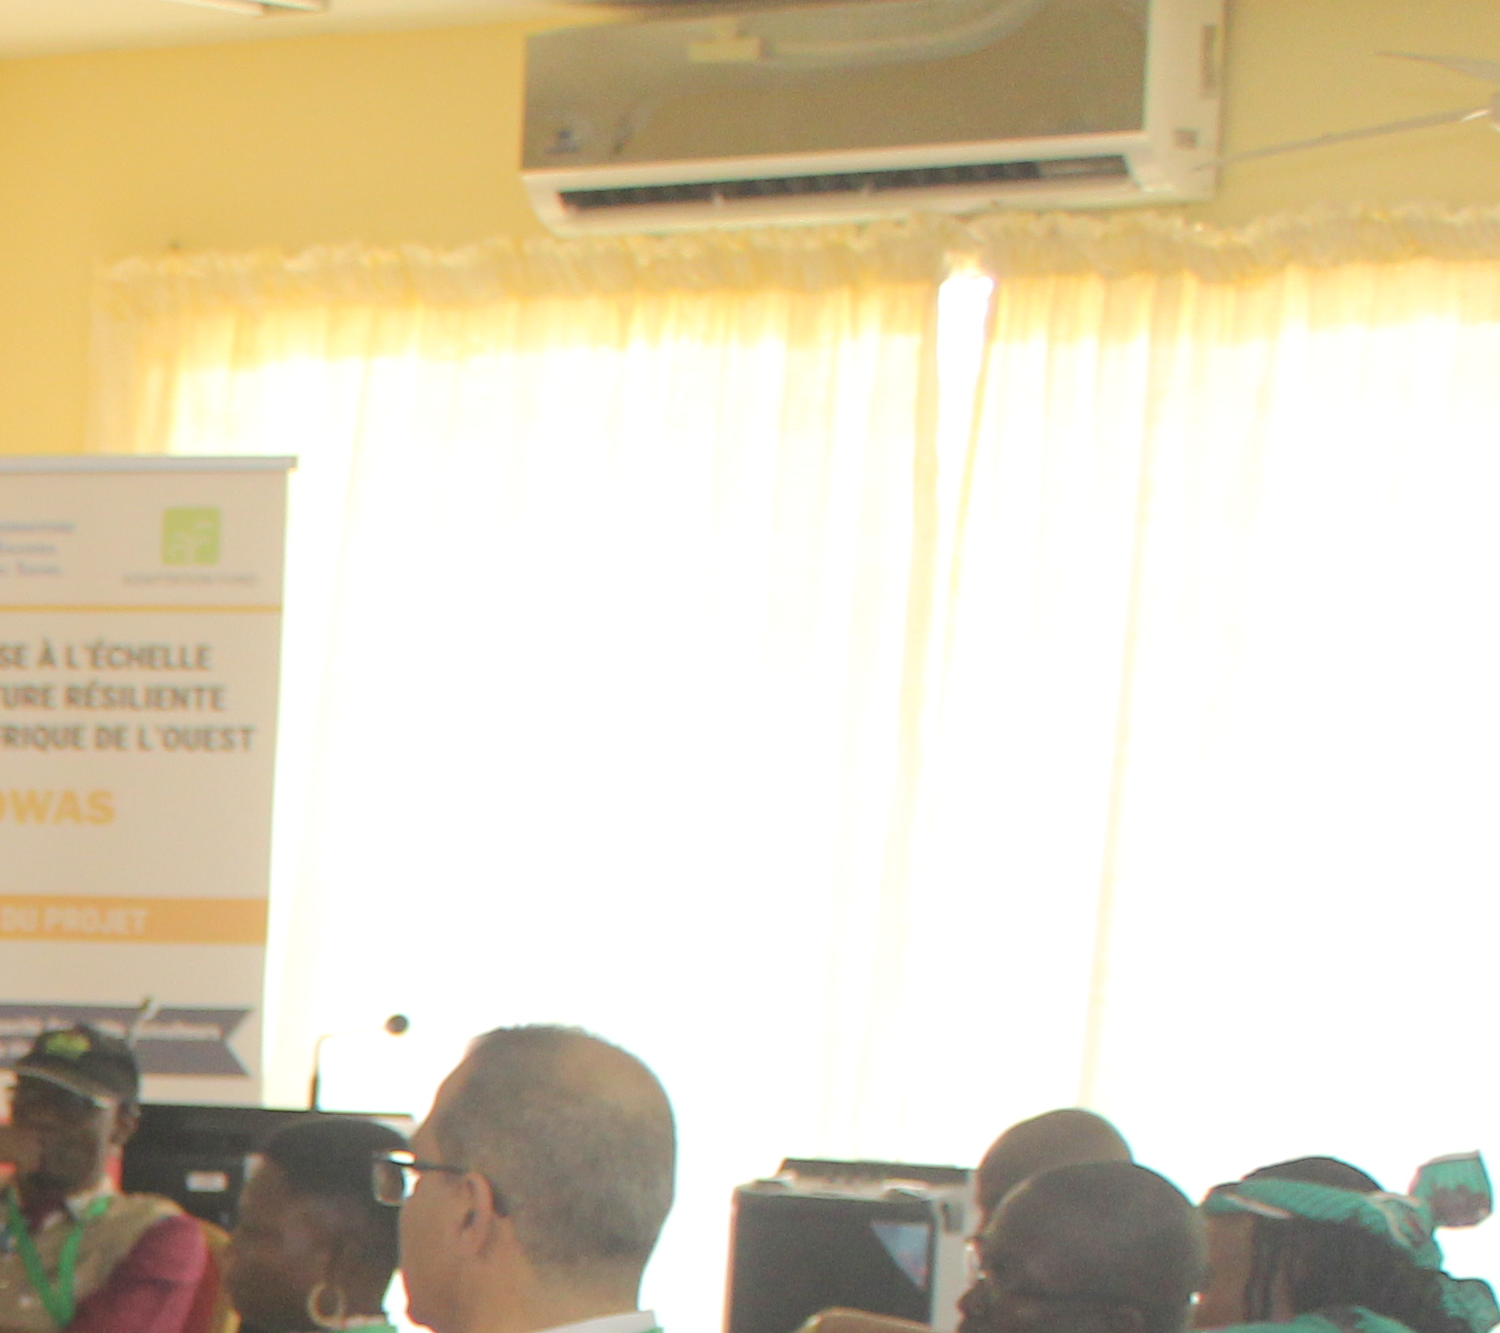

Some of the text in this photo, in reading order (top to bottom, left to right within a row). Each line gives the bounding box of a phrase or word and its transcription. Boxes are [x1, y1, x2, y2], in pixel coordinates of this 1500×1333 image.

[34, 636, 59, 670] À
[65, 636, 212, 671] L'ÉCHELLE
[64, 676, 227, 712] RÉSILIENTE
[96, 725, 130, 751] DE
[137, 725, 256, 752] L'OUEST
[0, 905, 39, 933] DU
[48, 906, 149, 936] PROJET
